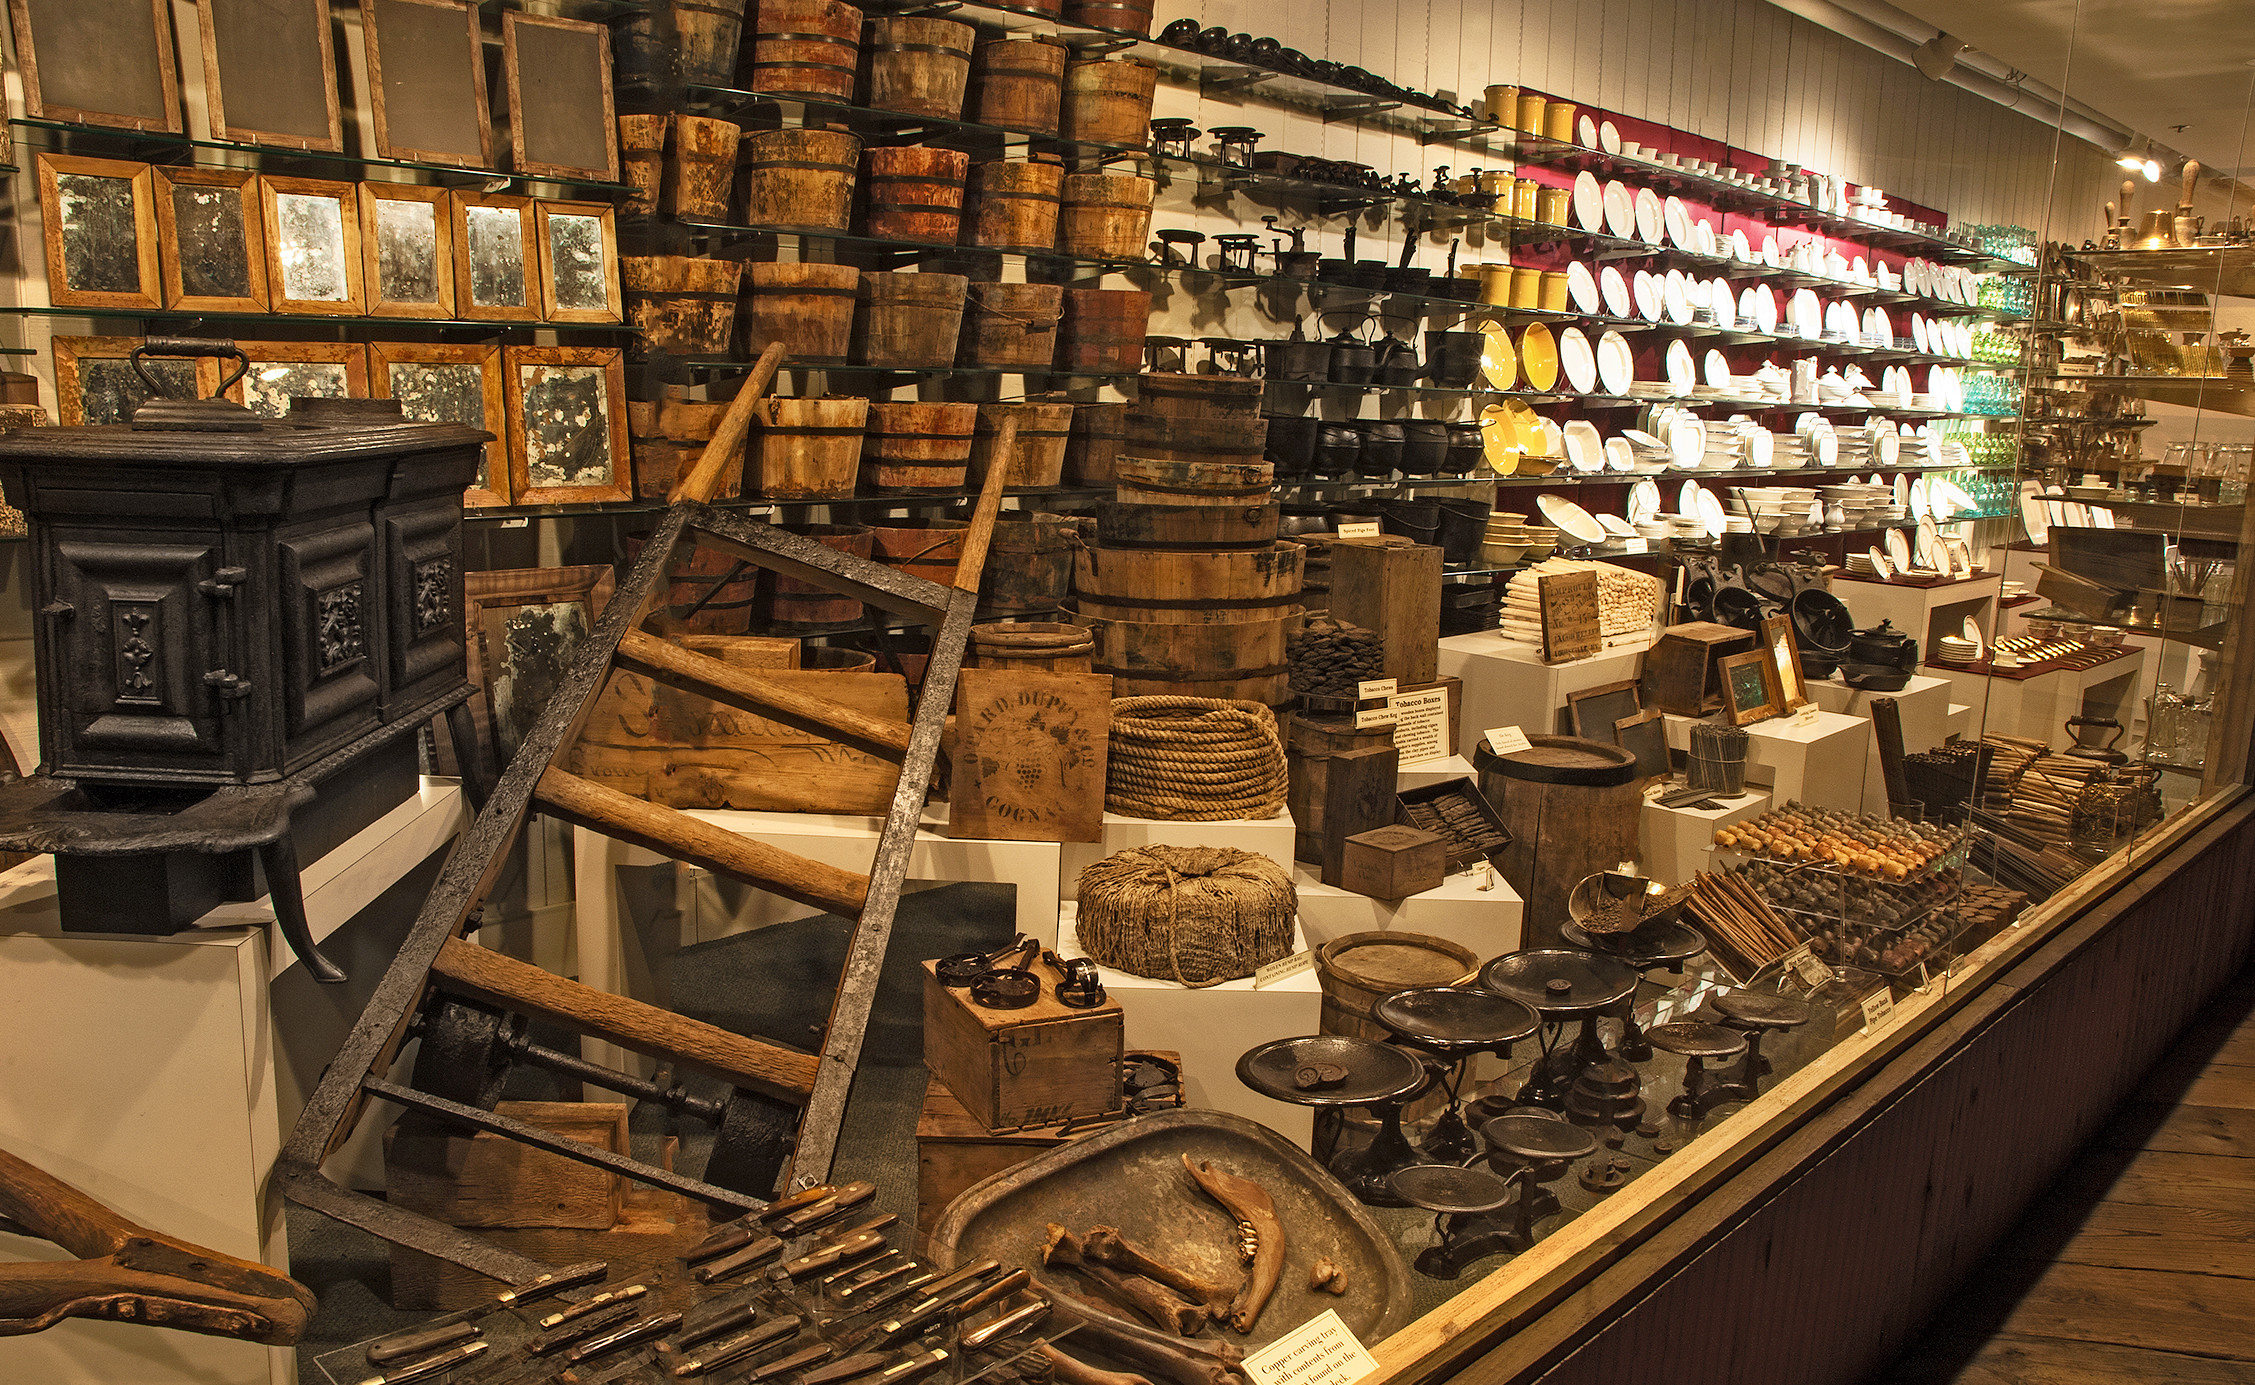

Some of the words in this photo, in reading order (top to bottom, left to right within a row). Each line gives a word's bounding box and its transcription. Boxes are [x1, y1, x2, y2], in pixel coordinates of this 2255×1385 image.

[1395, 700, 1422, 708] Tobacco
[1261, 1353, 1293, 1375] Copper
[1293, 1336, 1324, 1357] carving
[1321, 1326, 1338, 1339] tray
[1274, 1371, 1293, 1385] with
[1292, 1352, 1326, 1376] contents
[1323, 1340, 1345, 1356] from
[1308, 1363, 1333, 1384] found
[1332, 1359, 1344, 1370] on
[1343, 1351, 1357, 1364] the
